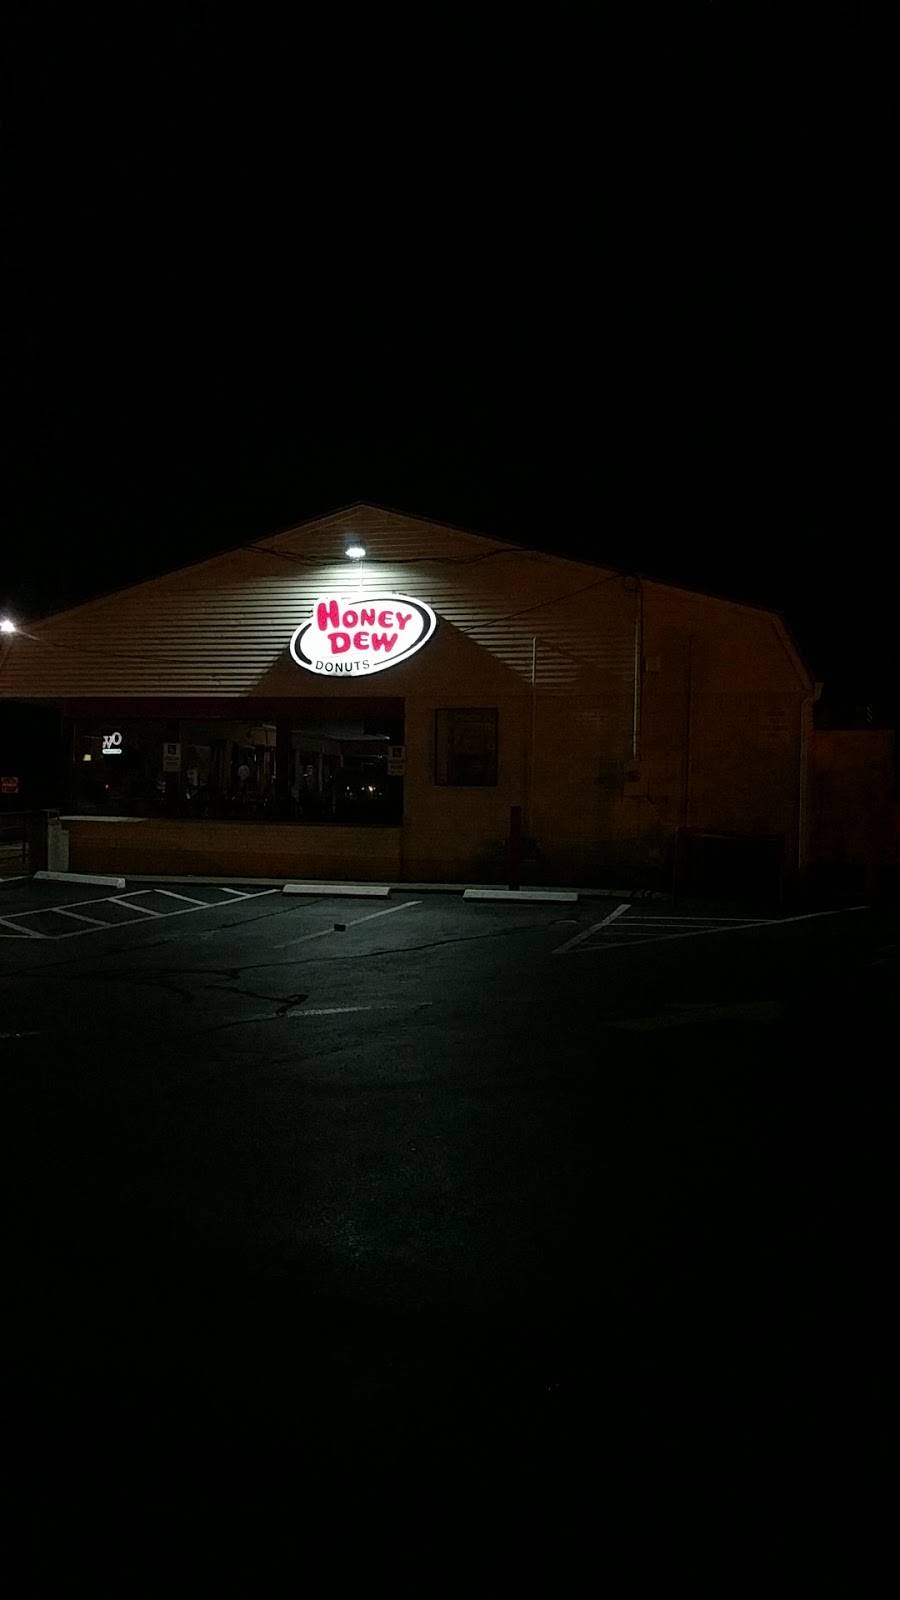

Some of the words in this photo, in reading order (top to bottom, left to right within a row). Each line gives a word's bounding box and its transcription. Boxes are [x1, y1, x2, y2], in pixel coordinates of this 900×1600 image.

[317, 600, 412, 631] HONEY
[327, 632, 398, 654] DEW
[315, 660, 370, 672] DONUTS
